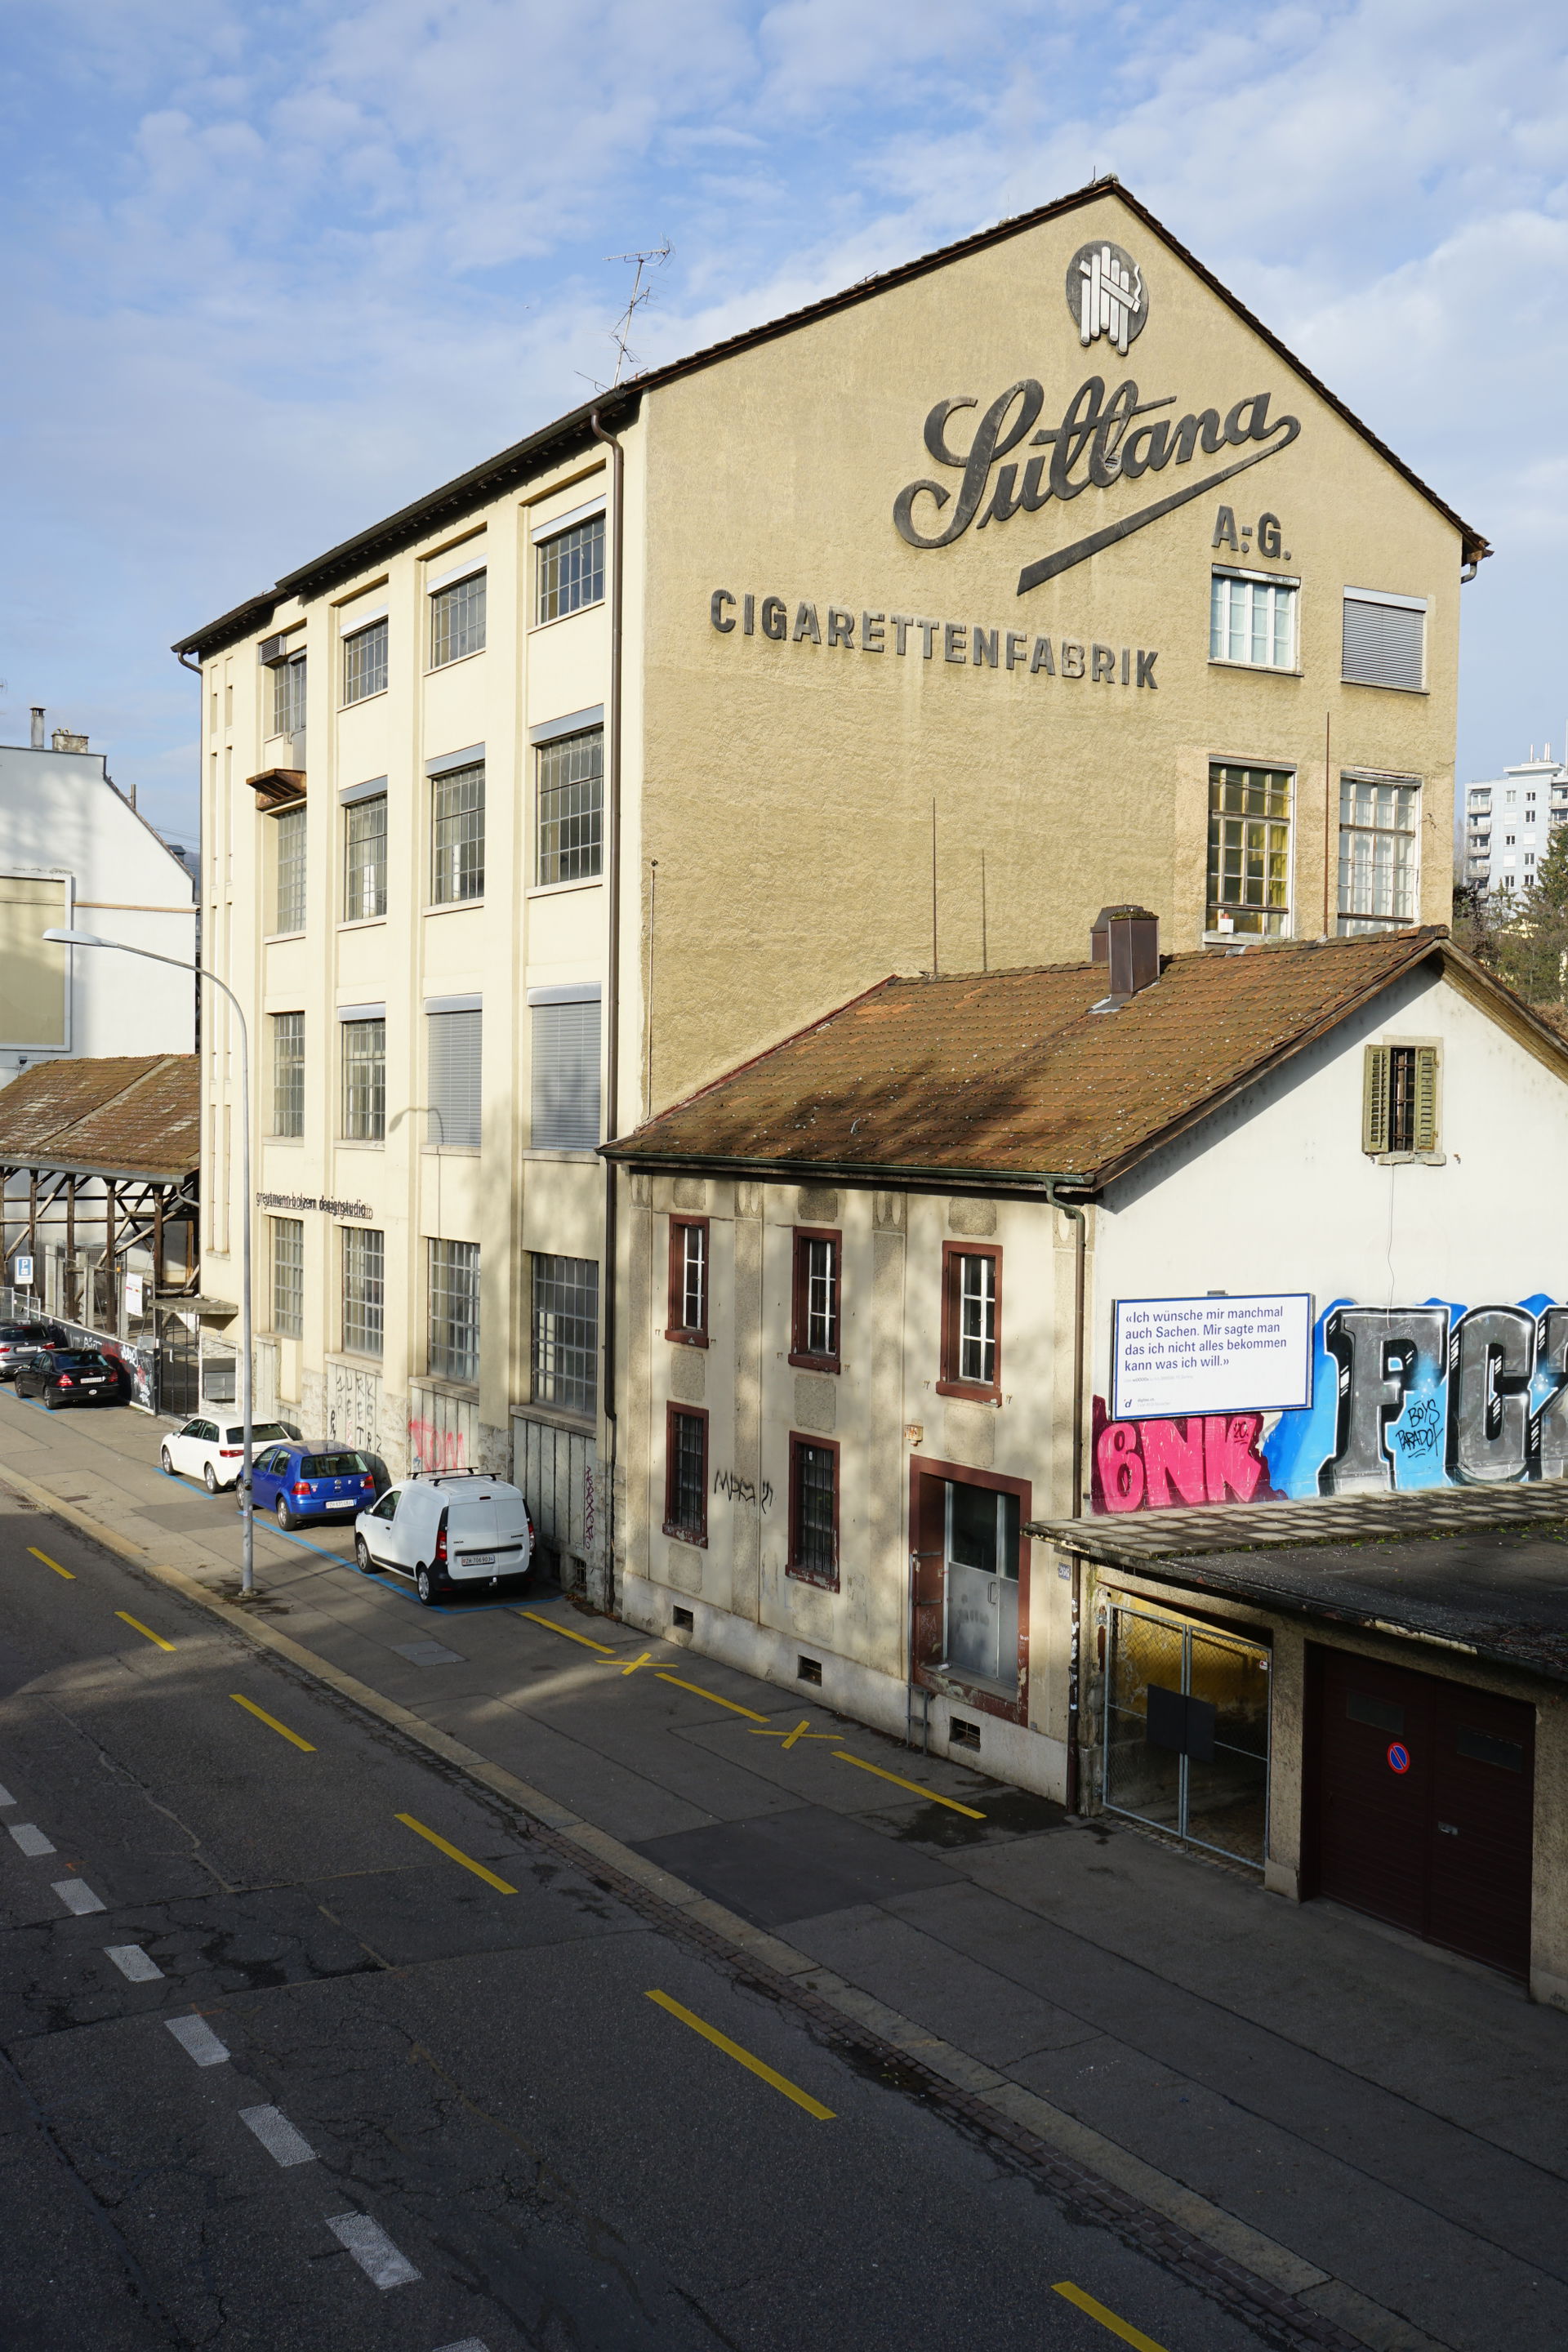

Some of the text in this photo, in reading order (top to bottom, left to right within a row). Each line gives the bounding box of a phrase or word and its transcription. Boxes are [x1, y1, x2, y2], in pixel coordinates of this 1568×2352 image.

[893, 376, 1301, 550] Sultana
[710, 588, 1159, 689] CIGARETTENFABRIK
[1152, 1309, 1203, 1322] wünsche
[1206, 1308, 1225, 1320] mir
[1227, 1305, 1283, 1319] manchmal
[1125, 1324, 1280, 1339] auch Sachen. Mir sagte man
[1125, 1339, 1286, 1356] das ich nicht alles bekommen
[1125, 1360, 1152, 1371] kann
[1155, 1360, 1178, 1370] was
[1181, 1356, 1197, 1368] ich
[1407, 1398, 1441, 1428] BOYS
[1395, 1424, 1444, 1457] PARADOX
